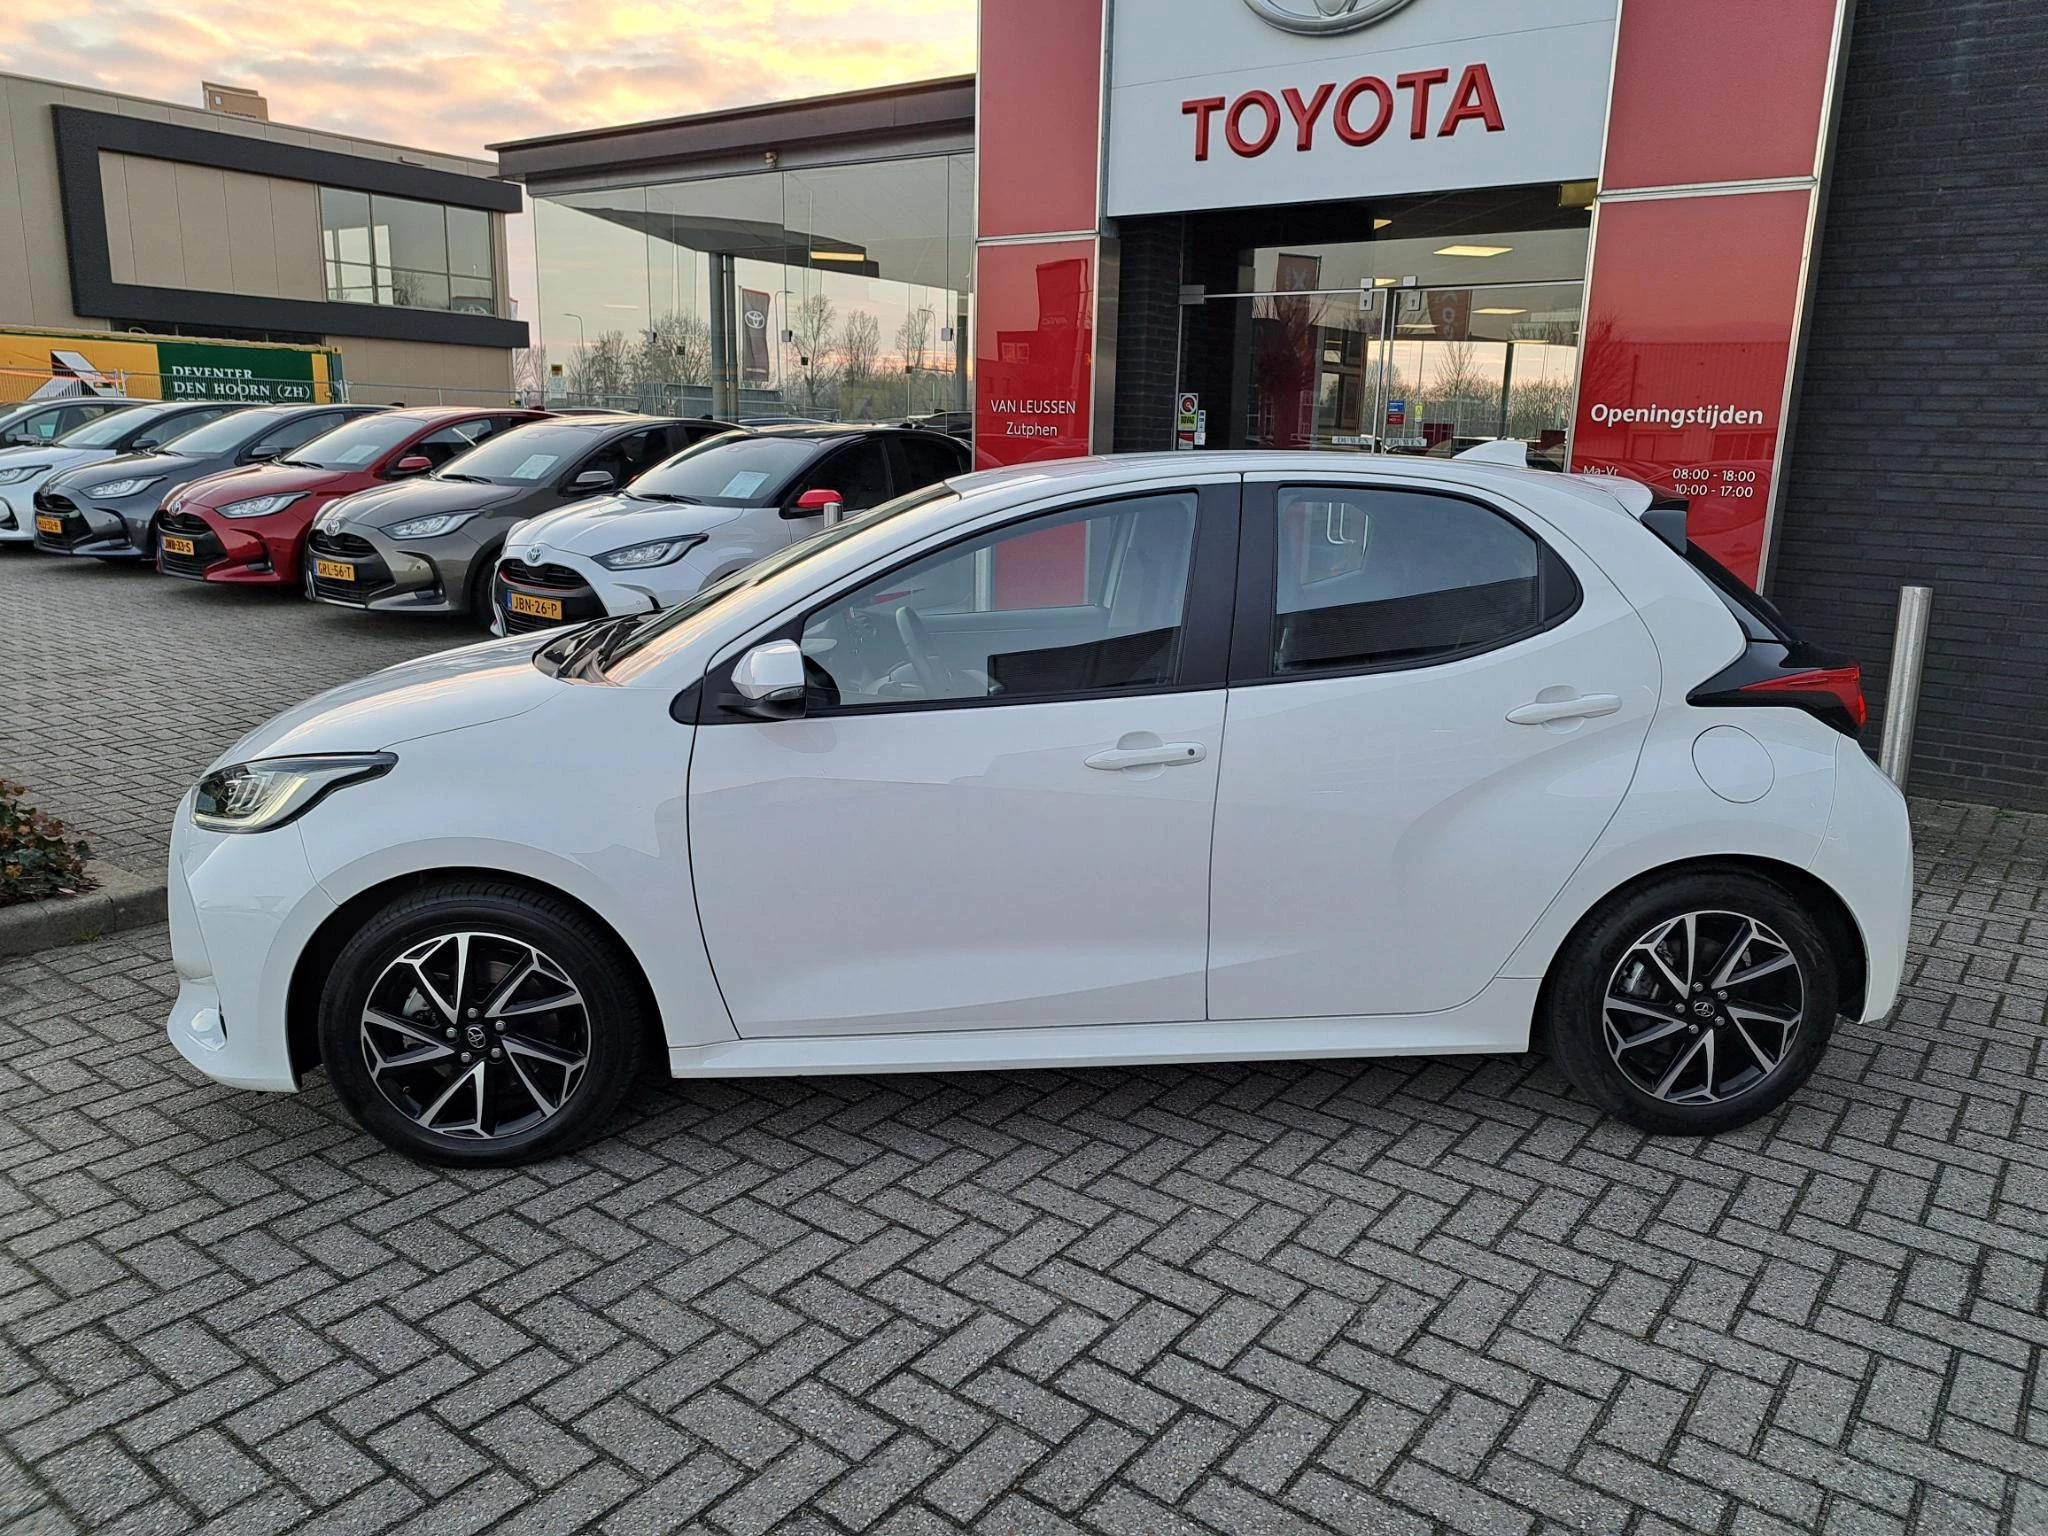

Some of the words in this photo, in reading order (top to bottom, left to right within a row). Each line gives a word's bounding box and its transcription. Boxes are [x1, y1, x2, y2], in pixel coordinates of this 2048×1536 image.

[1182, 63, 1505, 161] TOYOTA
[171, 366, 253, 379] DEVENTER
[173, 381, 206, 394] DEN
[214, 383, 270, 396] HOORN
[277, 384, 310, 399] (ZH)
[991, 399, 1016, 413] VAN
[1020, 399, 1076, 414] LEUSSEN
[1591, 403, 1763, 429] Openingstijden
[1006, 421, 1058, 438] Zutphen
[1583, 465, 1619, 476] Ma-Vr
[1672, 468, 1709, 480] 08:00
[1722, 470, 1756, 482] 18:00
[1674, 484, 1707, 495] 10:00
[1720, 485, 1753, 497] 17:00
[318, 562, 351, 579] GRL-56-T
[514, 596, 558, 616] JBN-26-P
